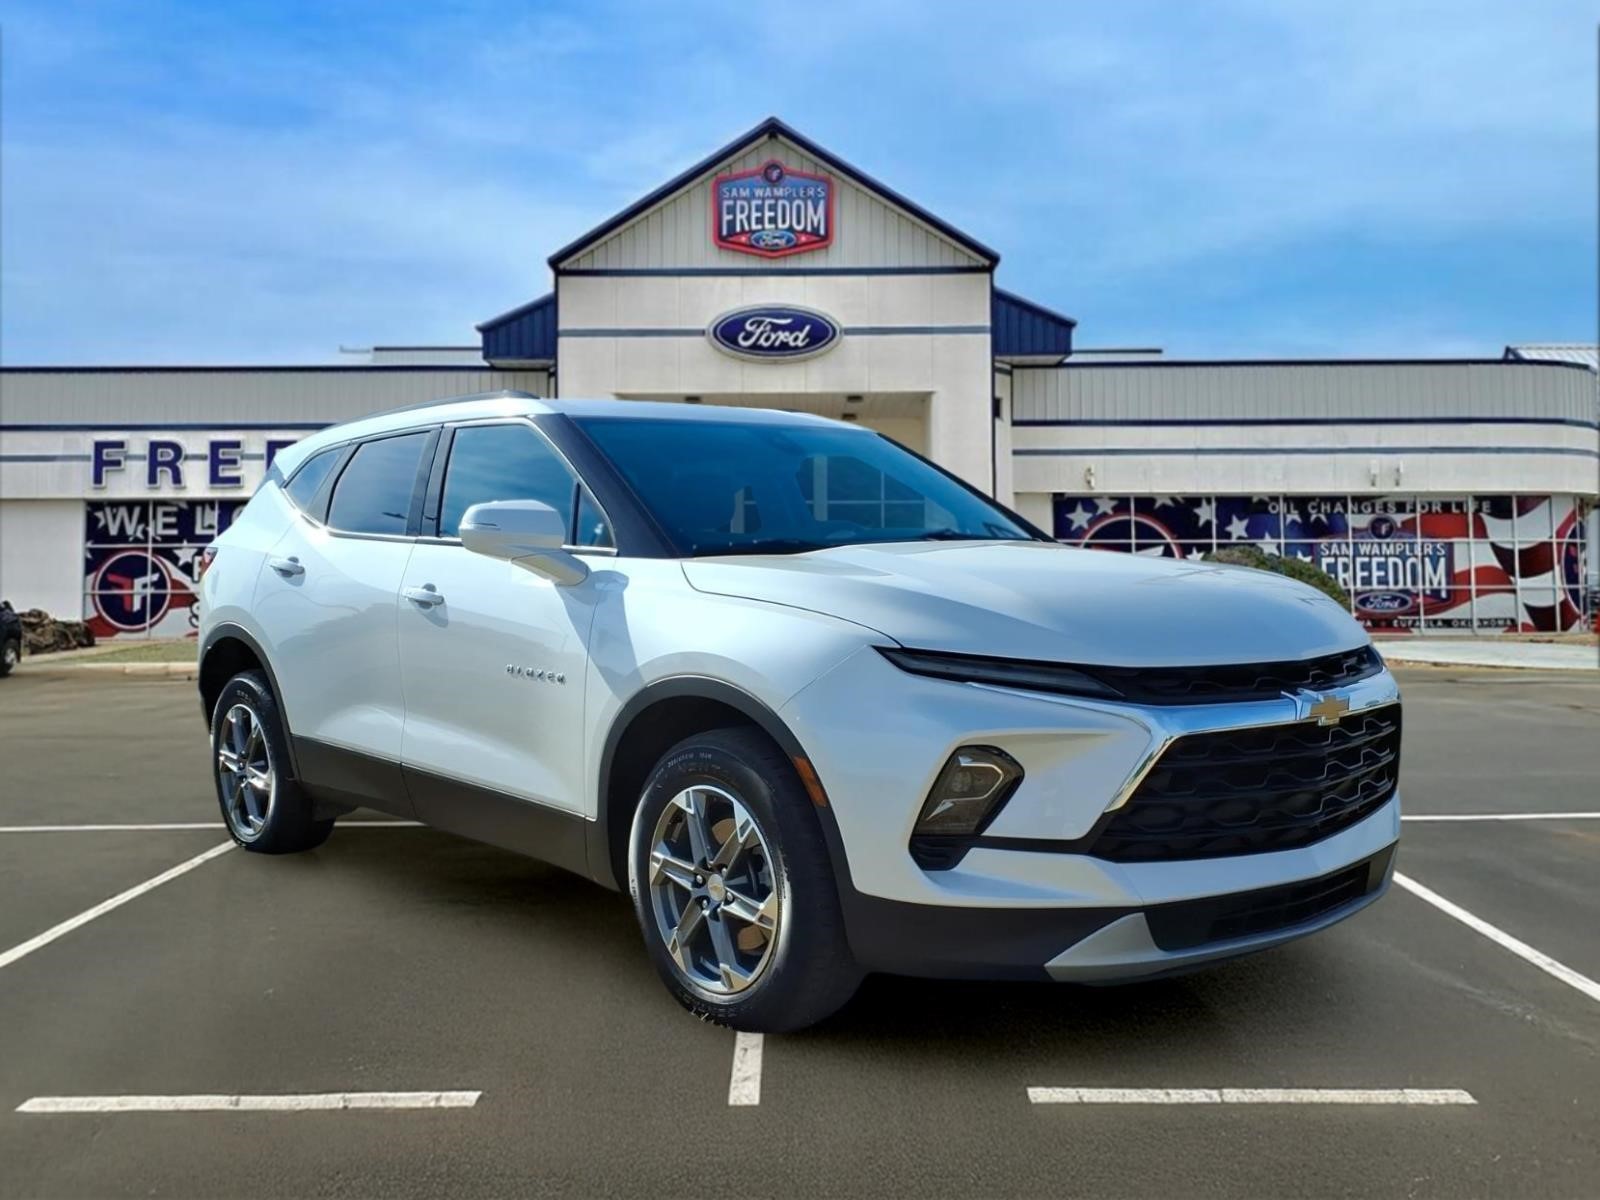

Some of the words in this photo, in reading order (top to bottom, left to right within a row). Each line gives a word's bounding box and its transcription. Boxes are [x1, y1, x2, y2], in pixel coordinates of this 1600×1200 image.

[722, 186, 750, 198] SAM
[722, 199, 825, 236] FREEDOM
[738, 316, 811, 348] Ford
[1268, 502, 1299, 514] OIL
[1307, 502, 1397, 514] CHANGES
[1406, 501, 1442, 513] FOR
[1452, 501, 1491, 513] LIFE
[1320, 542, 1354, 556] SAM
[1321, 556, 1447, 598] FREEDOM
[1366, 595, 1399, 608] Ford
